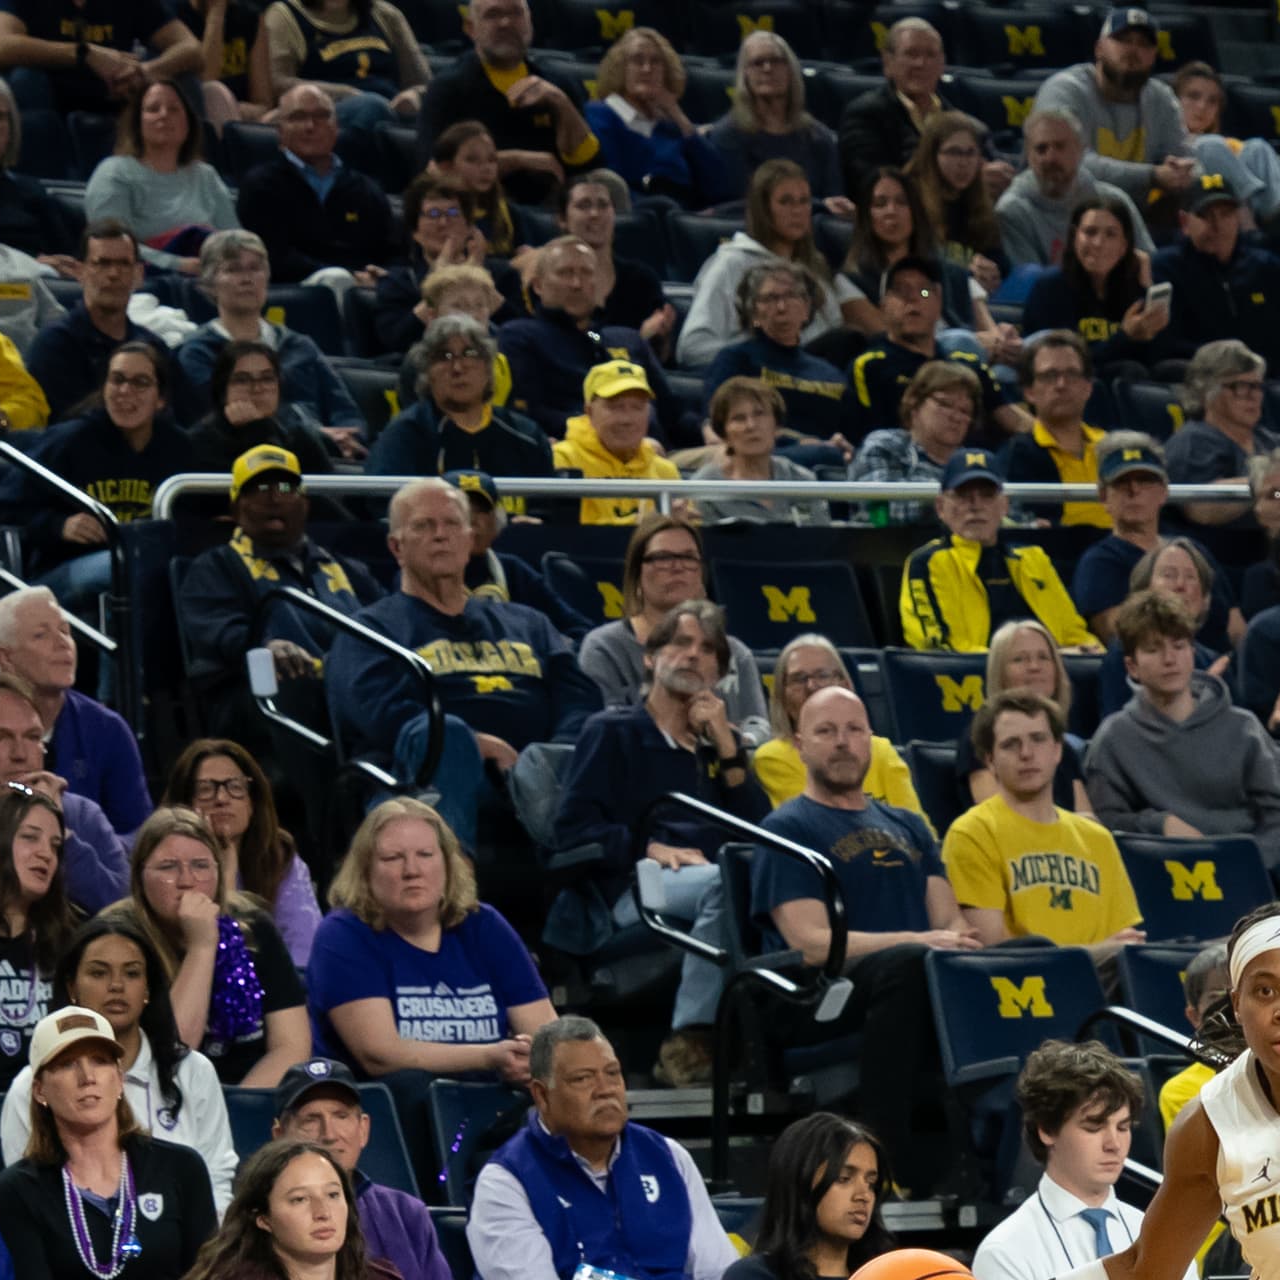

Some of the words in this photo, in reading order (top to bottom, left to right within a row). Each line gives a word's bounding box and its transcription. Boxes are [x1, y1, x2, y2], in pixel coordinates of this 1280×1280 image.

[1005, 25, 1045, 55] M
[762, 586, 816, 622] M
[473, 675, 512, 693] M
[936, 675, 985, 712] M
[1165, 860, 1223, 900] M
[396, 993, 498, 1019] CRUSADERS
[990, 976, 1054, 1019] M
[399, 1018, 501, 1043] BASKETBALL
